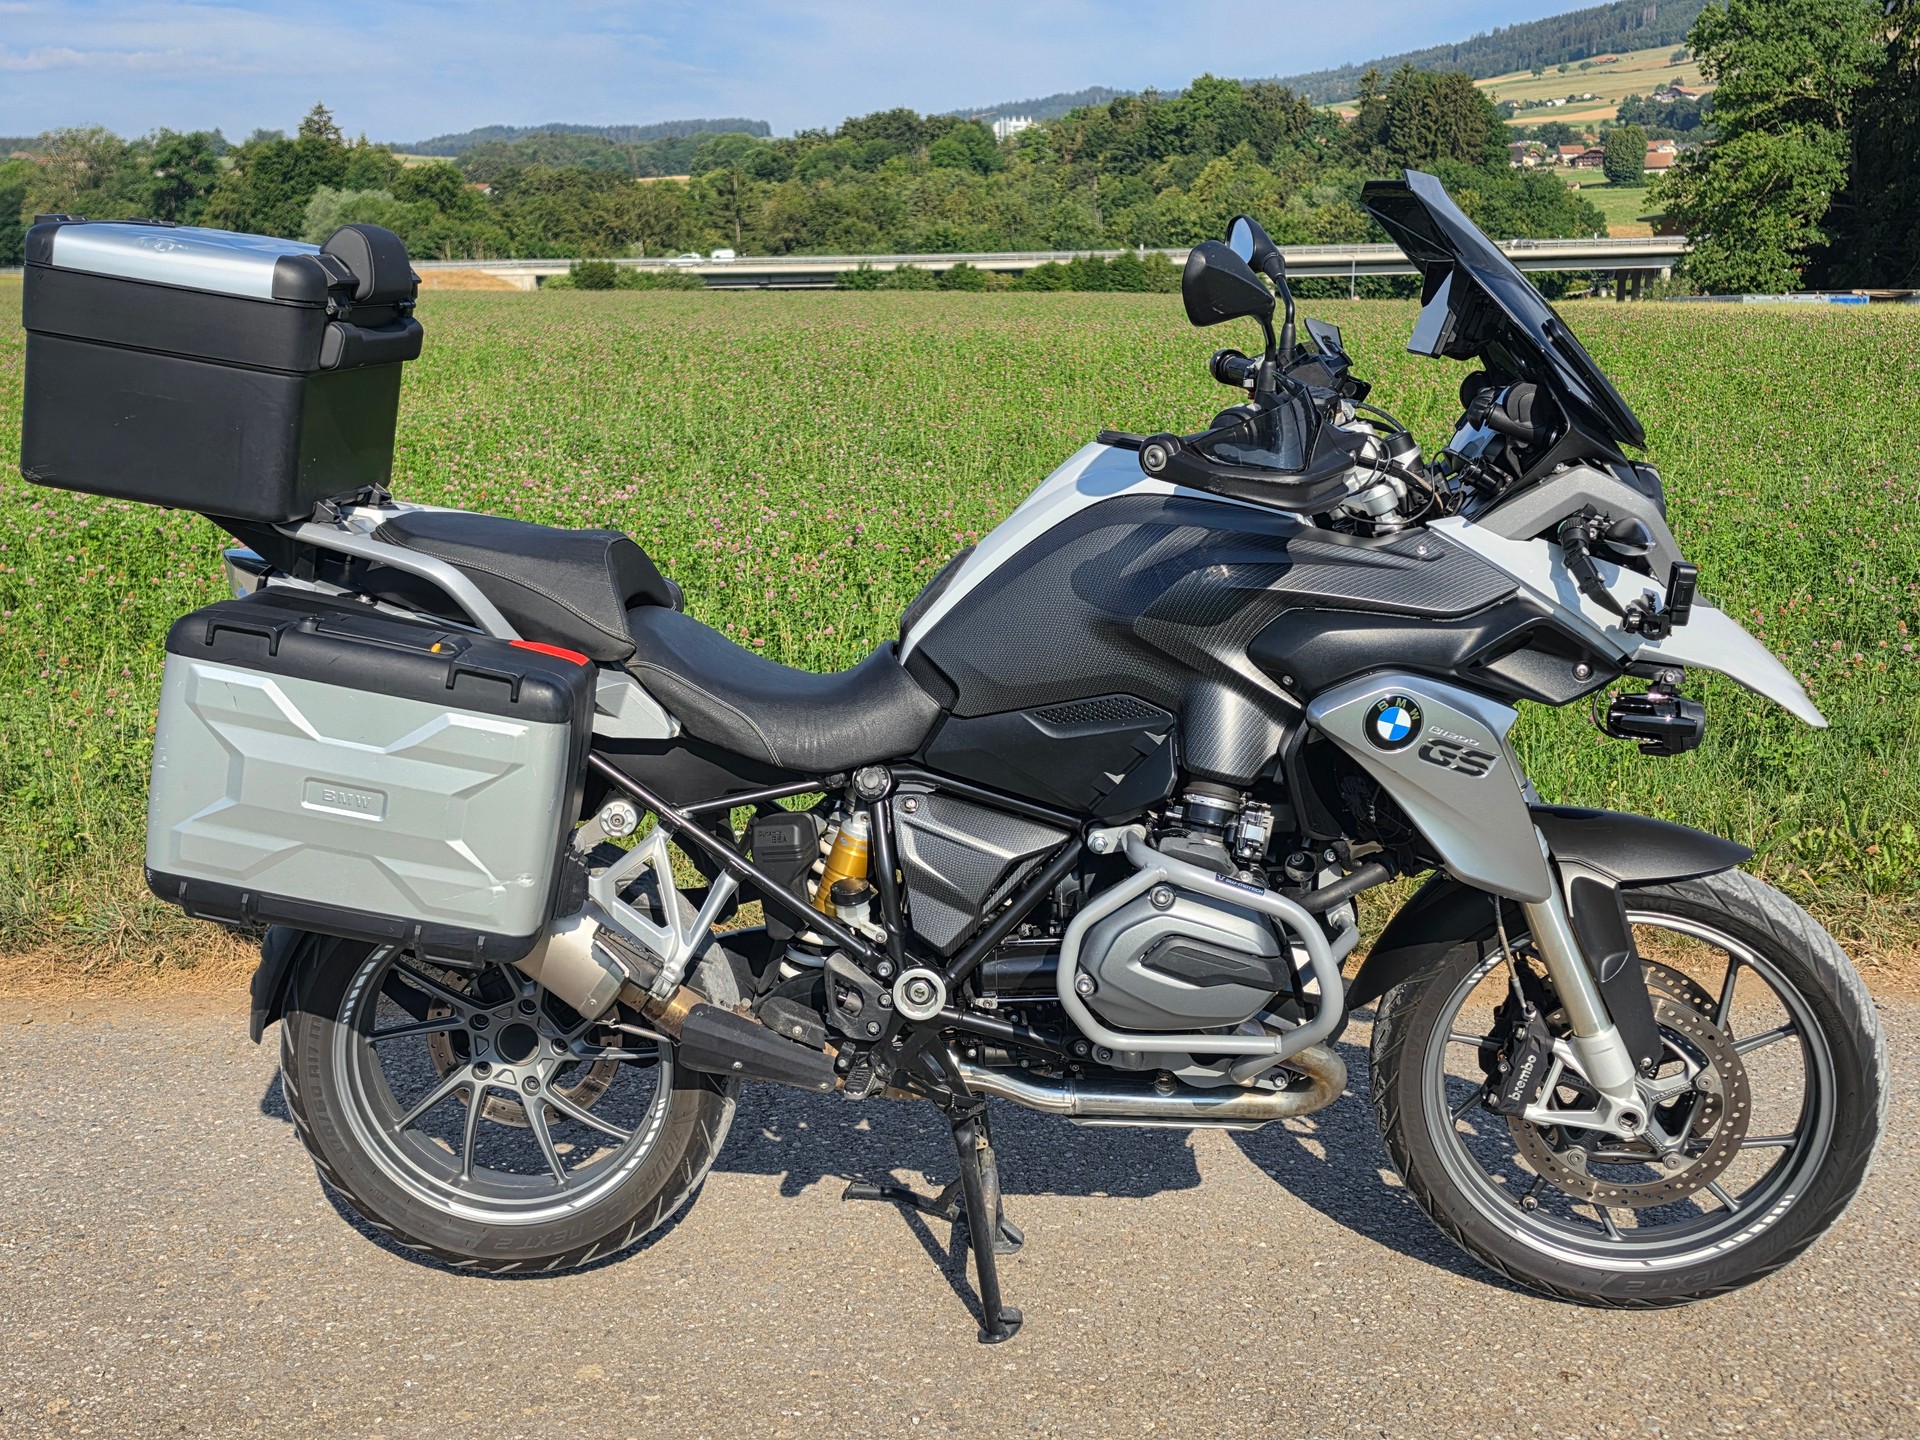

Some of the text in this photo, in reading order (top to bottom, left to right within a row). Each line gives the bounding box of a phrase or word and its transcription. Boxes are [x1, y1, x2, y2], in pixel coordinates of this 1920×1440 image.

[1377, 697, 1420, 720] BMW
[1418, 738, 1499, 778] GS
[322, 788, 373, 809] BMW
[1508, 1054, 1537, 1101] brembo
[494, 1237, 516, 1250] 2
[521, 1222, 585, 1250] NEXT
[1625, 1265, 1730, 1293] NEXT 2
